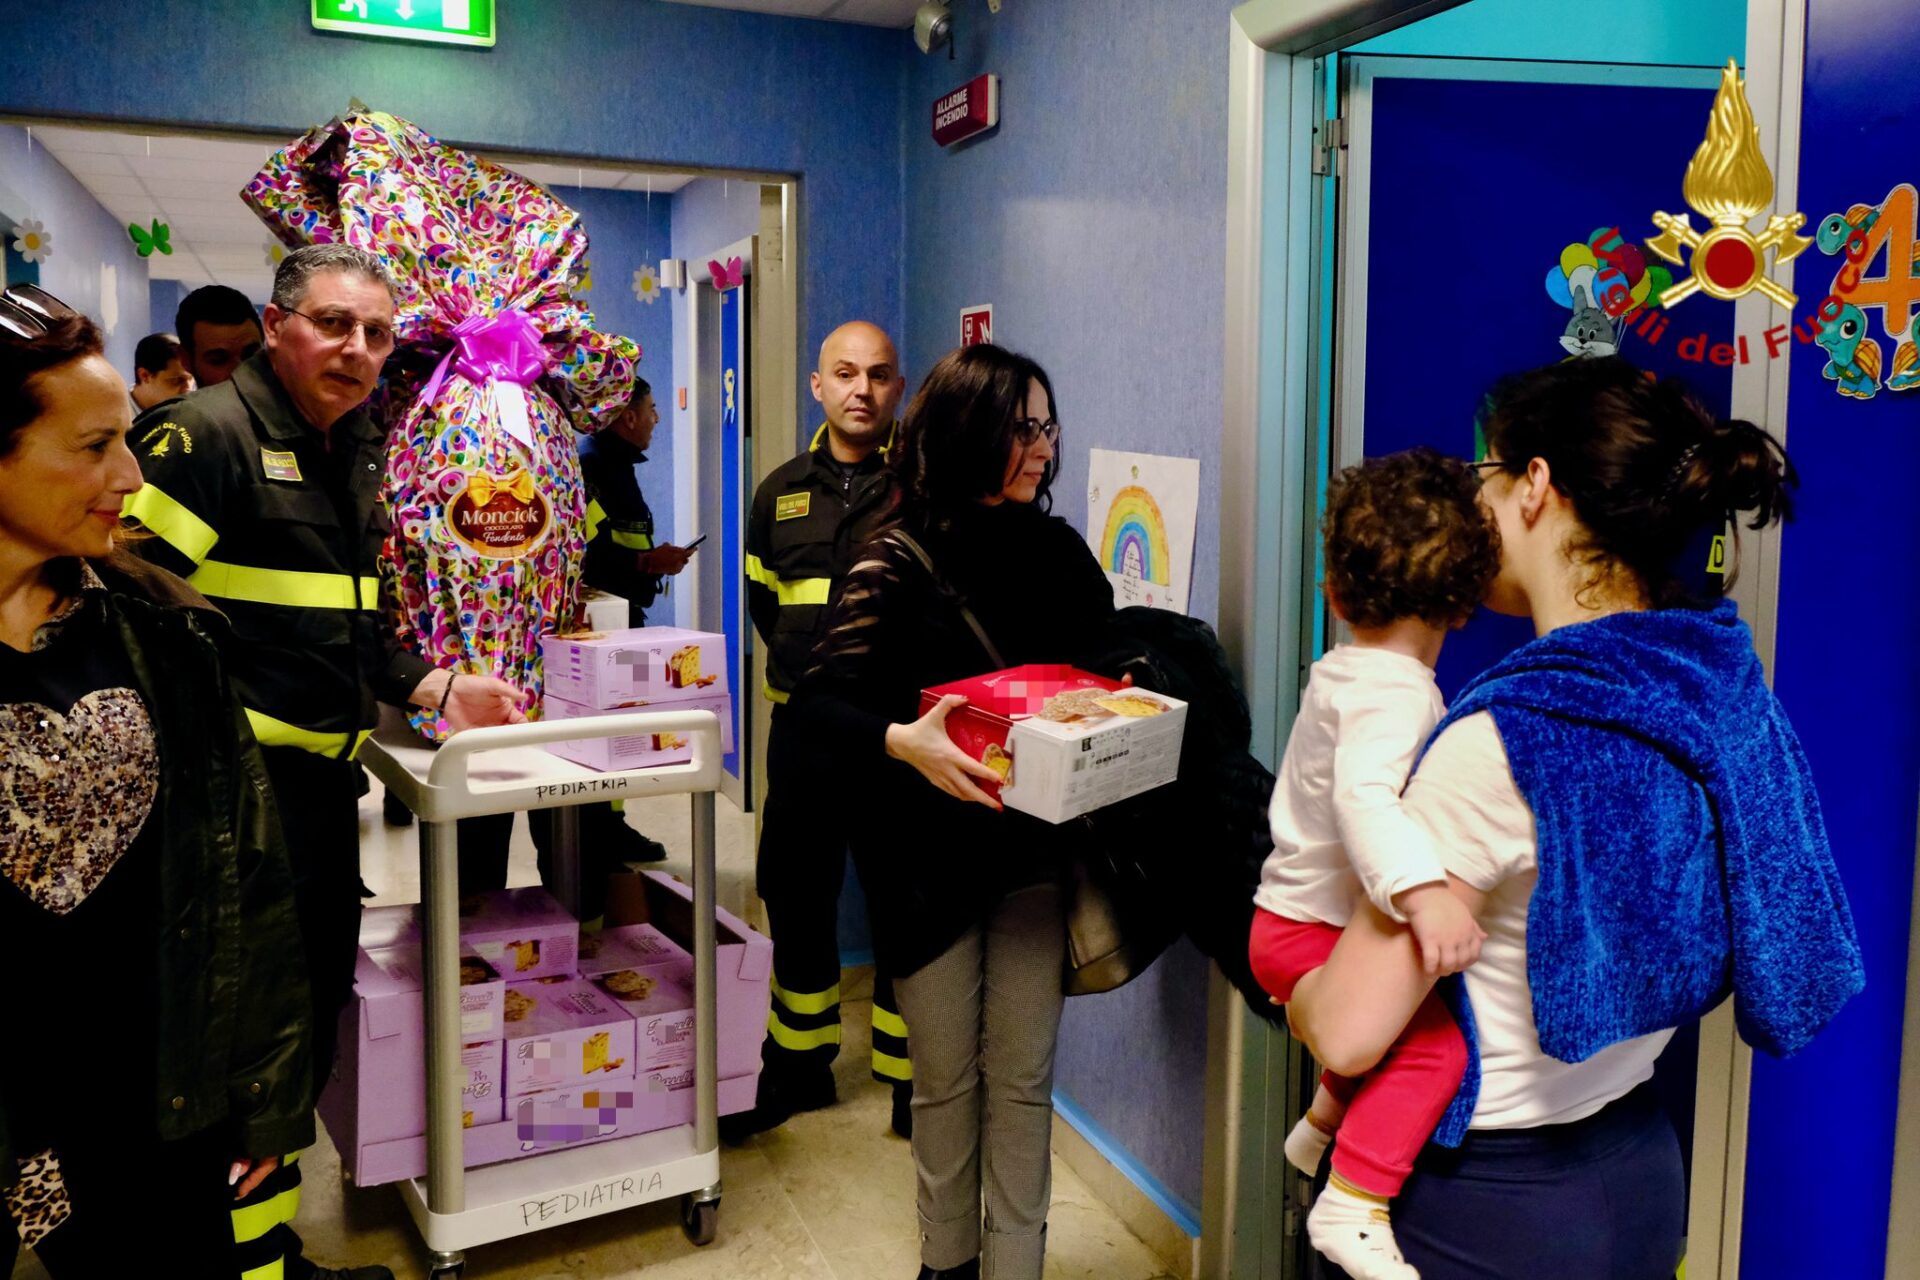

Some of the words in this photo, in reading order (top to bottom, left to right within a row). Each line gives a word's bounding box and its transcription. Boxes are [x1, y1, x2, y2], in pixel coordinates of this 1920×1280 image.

[936, 88, 968, 116] ALLARME
[935, 103, 969, 131] INCENDIO
[482, 530, 526, 544] Fondente
[519, 1171, 664, 1227] PEDIATRIA
